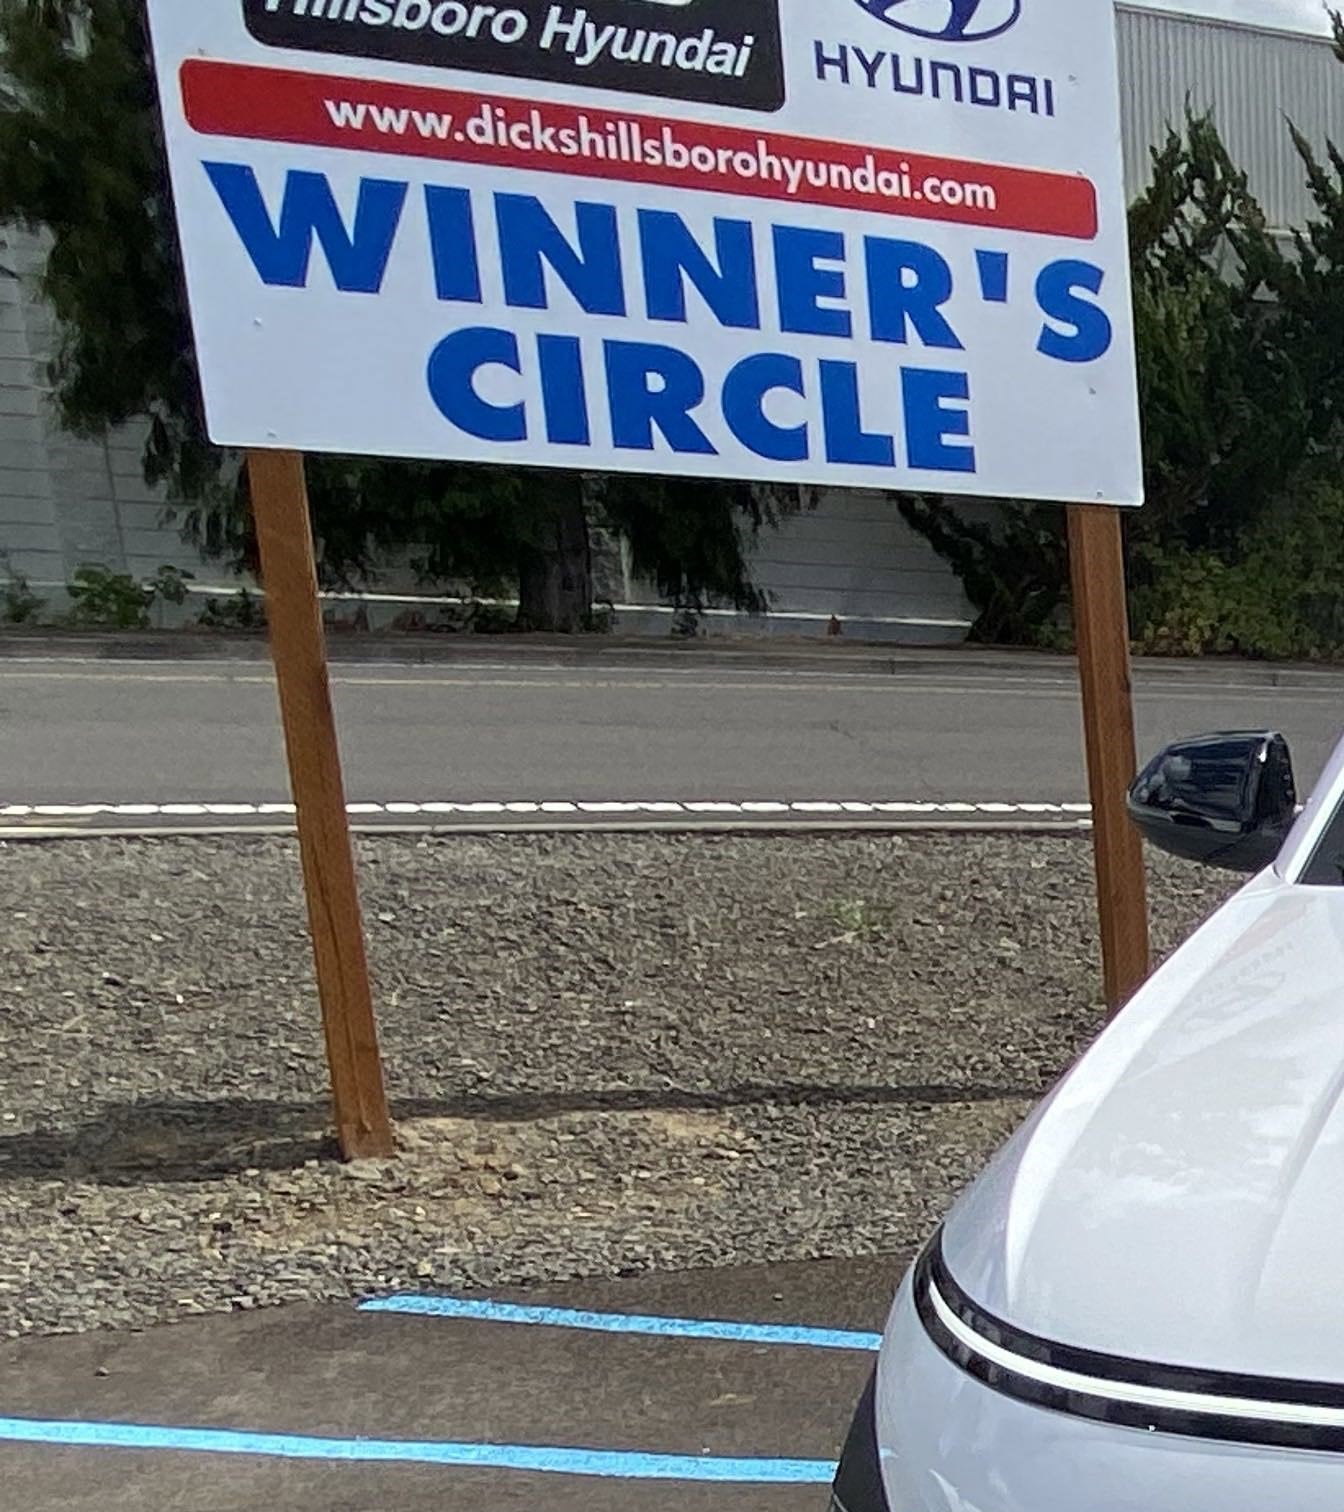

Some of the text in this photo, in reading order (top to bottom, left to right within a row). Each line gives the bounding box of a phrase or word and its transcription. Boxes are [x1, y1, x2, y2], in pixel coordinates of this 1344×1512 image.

[263, 0, 755, 77] sboro Hyundai
[814, 40, 1055, 117] HYUNDAI
[325, 100, 997, 211] www.dickshillsborohyundai.com
[201, 160, 1113, 363] WINNER'S
[426, 326, 977, 473] CIRCLE
